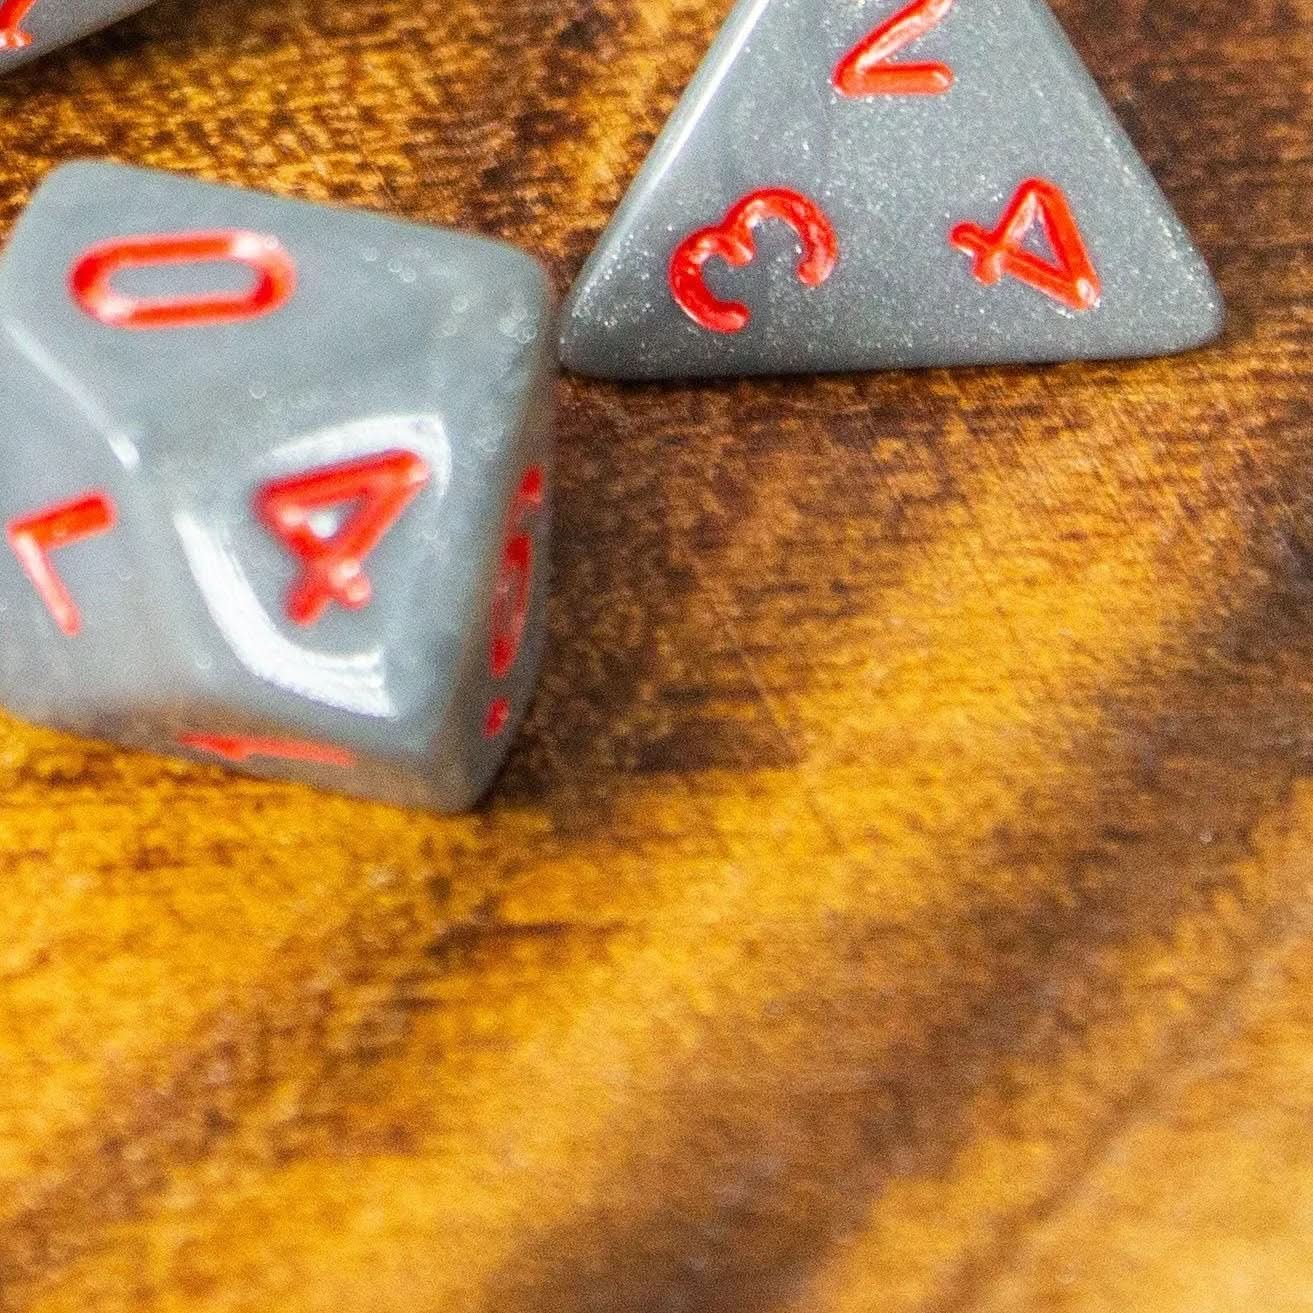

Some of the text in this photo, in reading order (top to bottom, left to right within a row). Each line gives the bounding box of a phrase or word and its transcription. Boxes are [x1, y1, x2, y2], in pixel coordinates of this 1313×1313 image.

[65, 227, 298, 331] 0
[667, 184, 839, 336] 3
[947, 175, 1102, 312] 4
[6, 488, 118, 637] 7
[249, 447, 428, 627] 4
